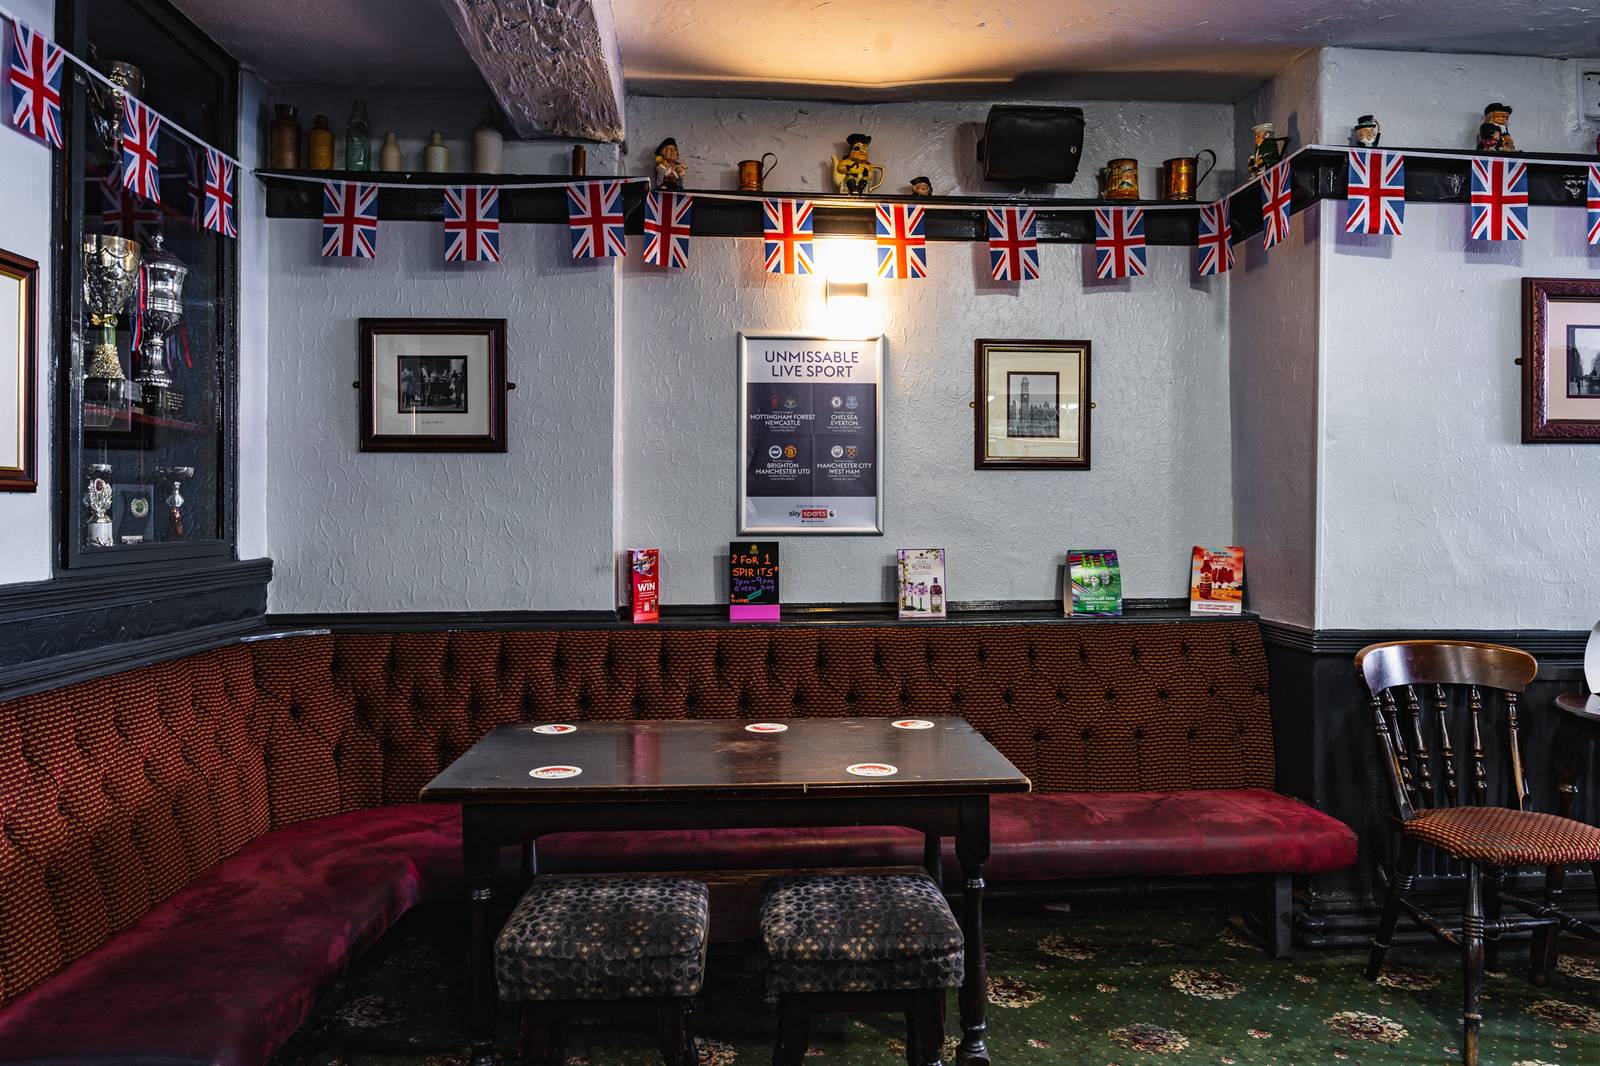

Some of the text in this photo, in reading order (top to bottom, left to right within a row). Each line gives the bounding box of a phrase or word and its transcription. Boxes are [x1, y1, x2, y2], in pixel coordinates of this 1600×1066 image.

[764, 351, 859, 363] UNMISSABLE
[772, 365, 853, 378] LIVE SPORT
[732, 554, 771, 564] 2 FOR 1
[638, 582, 656, 592] WIN
